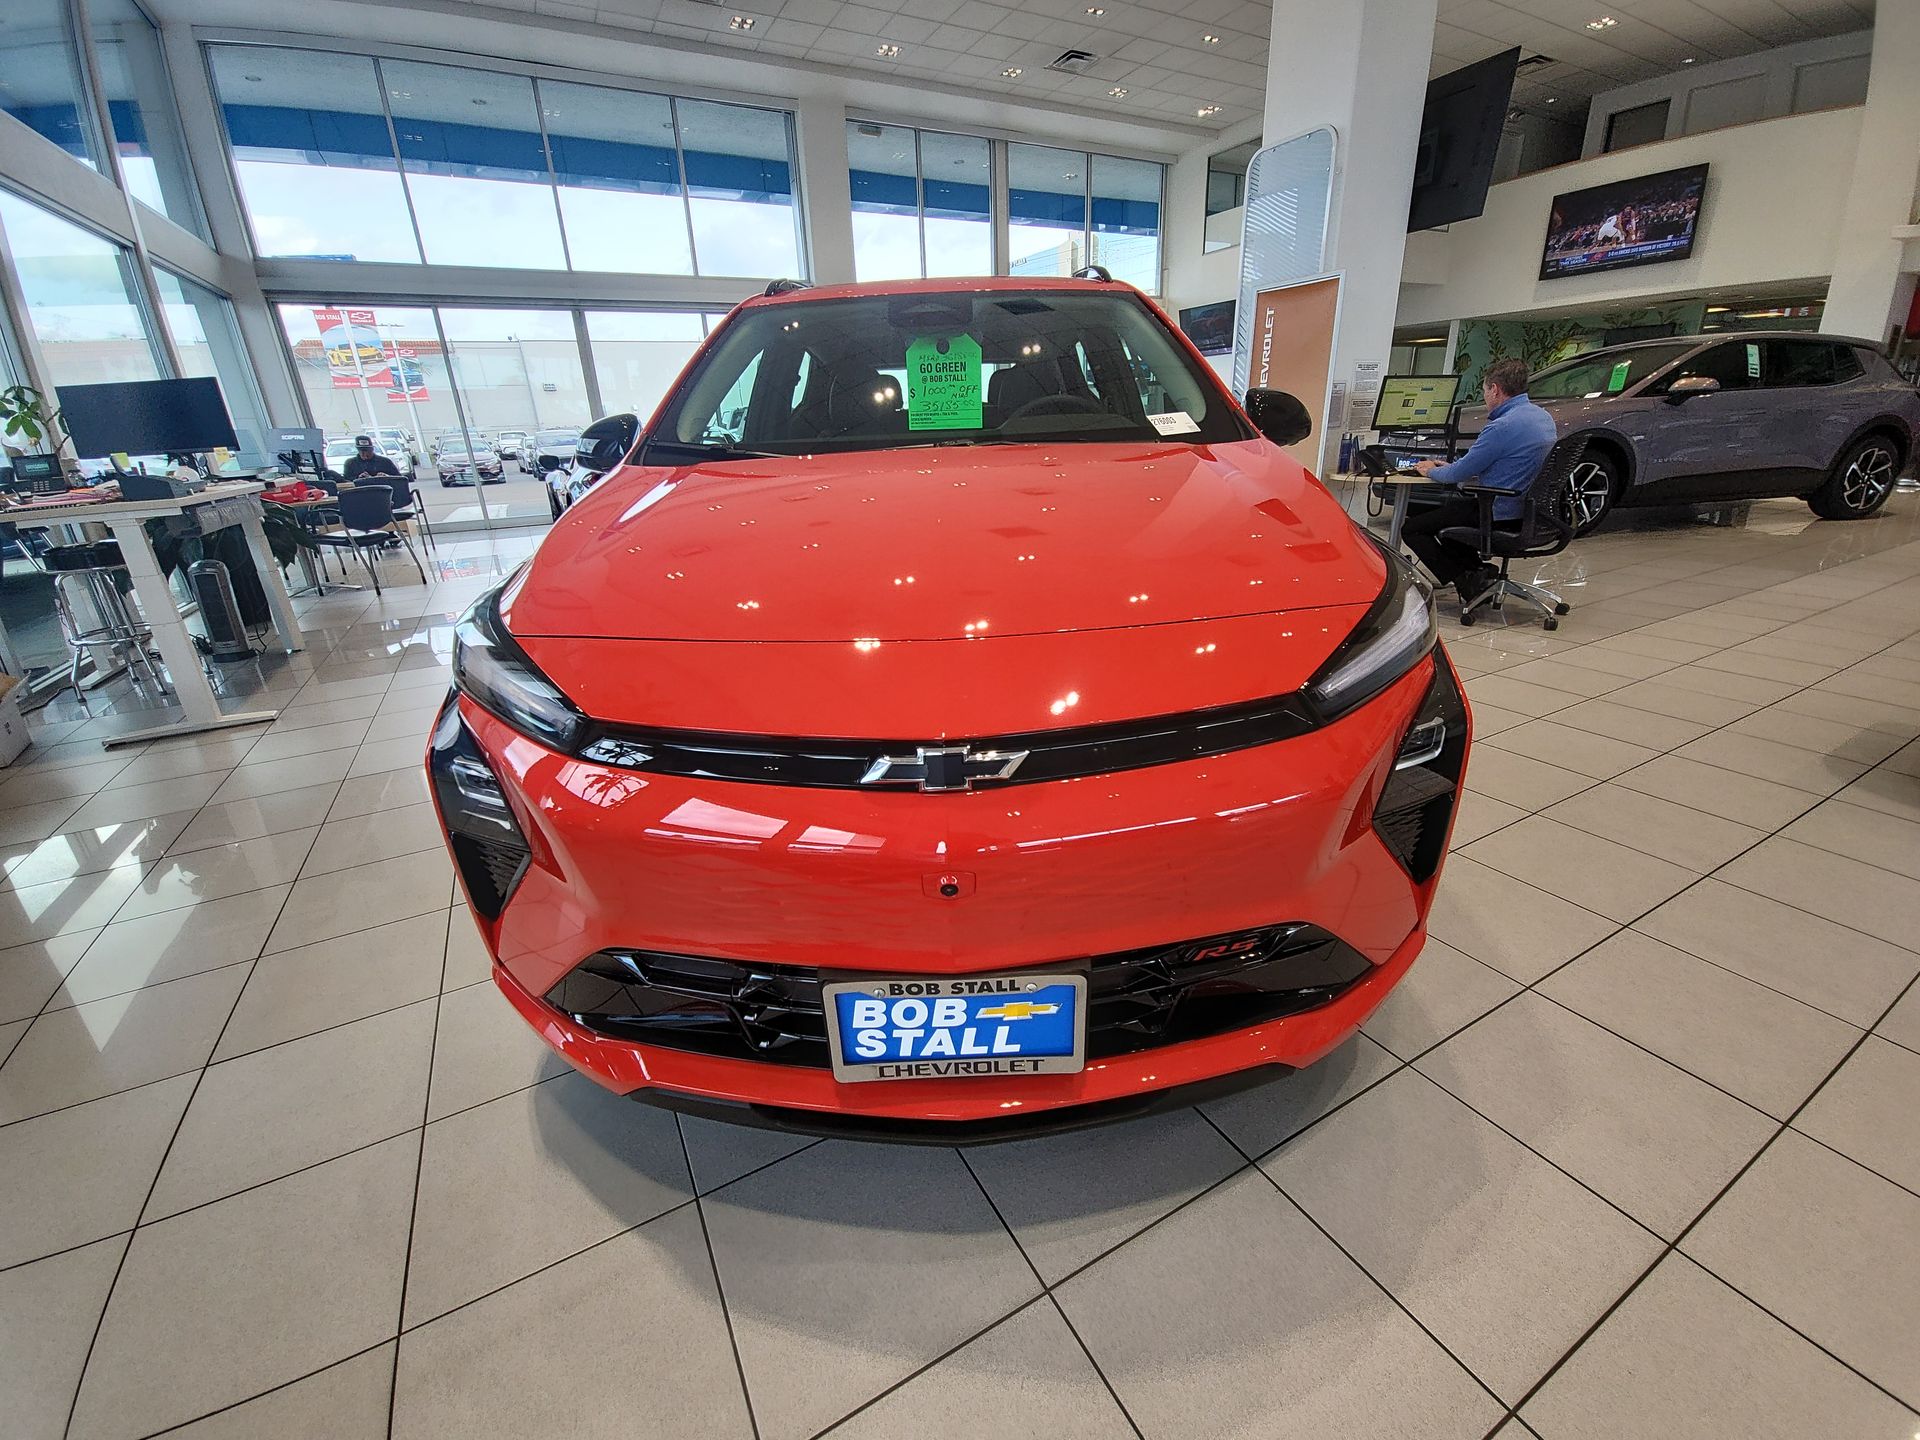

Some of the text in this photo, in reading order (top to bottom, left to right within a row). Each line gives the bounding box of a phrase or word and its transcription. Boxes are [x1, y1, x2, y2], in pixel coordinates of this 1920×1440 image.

[919, 361, 967, 374] GO GREEN
[921, 374, 967, 385] @ BOB STALL!
[910, 387, 916, 399] $
[959, 384, 979, 394] OFF
[1193, 938, 1259, 961] RS
[888, 979, 1021, 996] BOB STALL
[852, 998, 968, 1029] BOB
[855, 1025, 1022, 1058] STALL
[878, 1058, 1045, 1079] CHEVROLET
